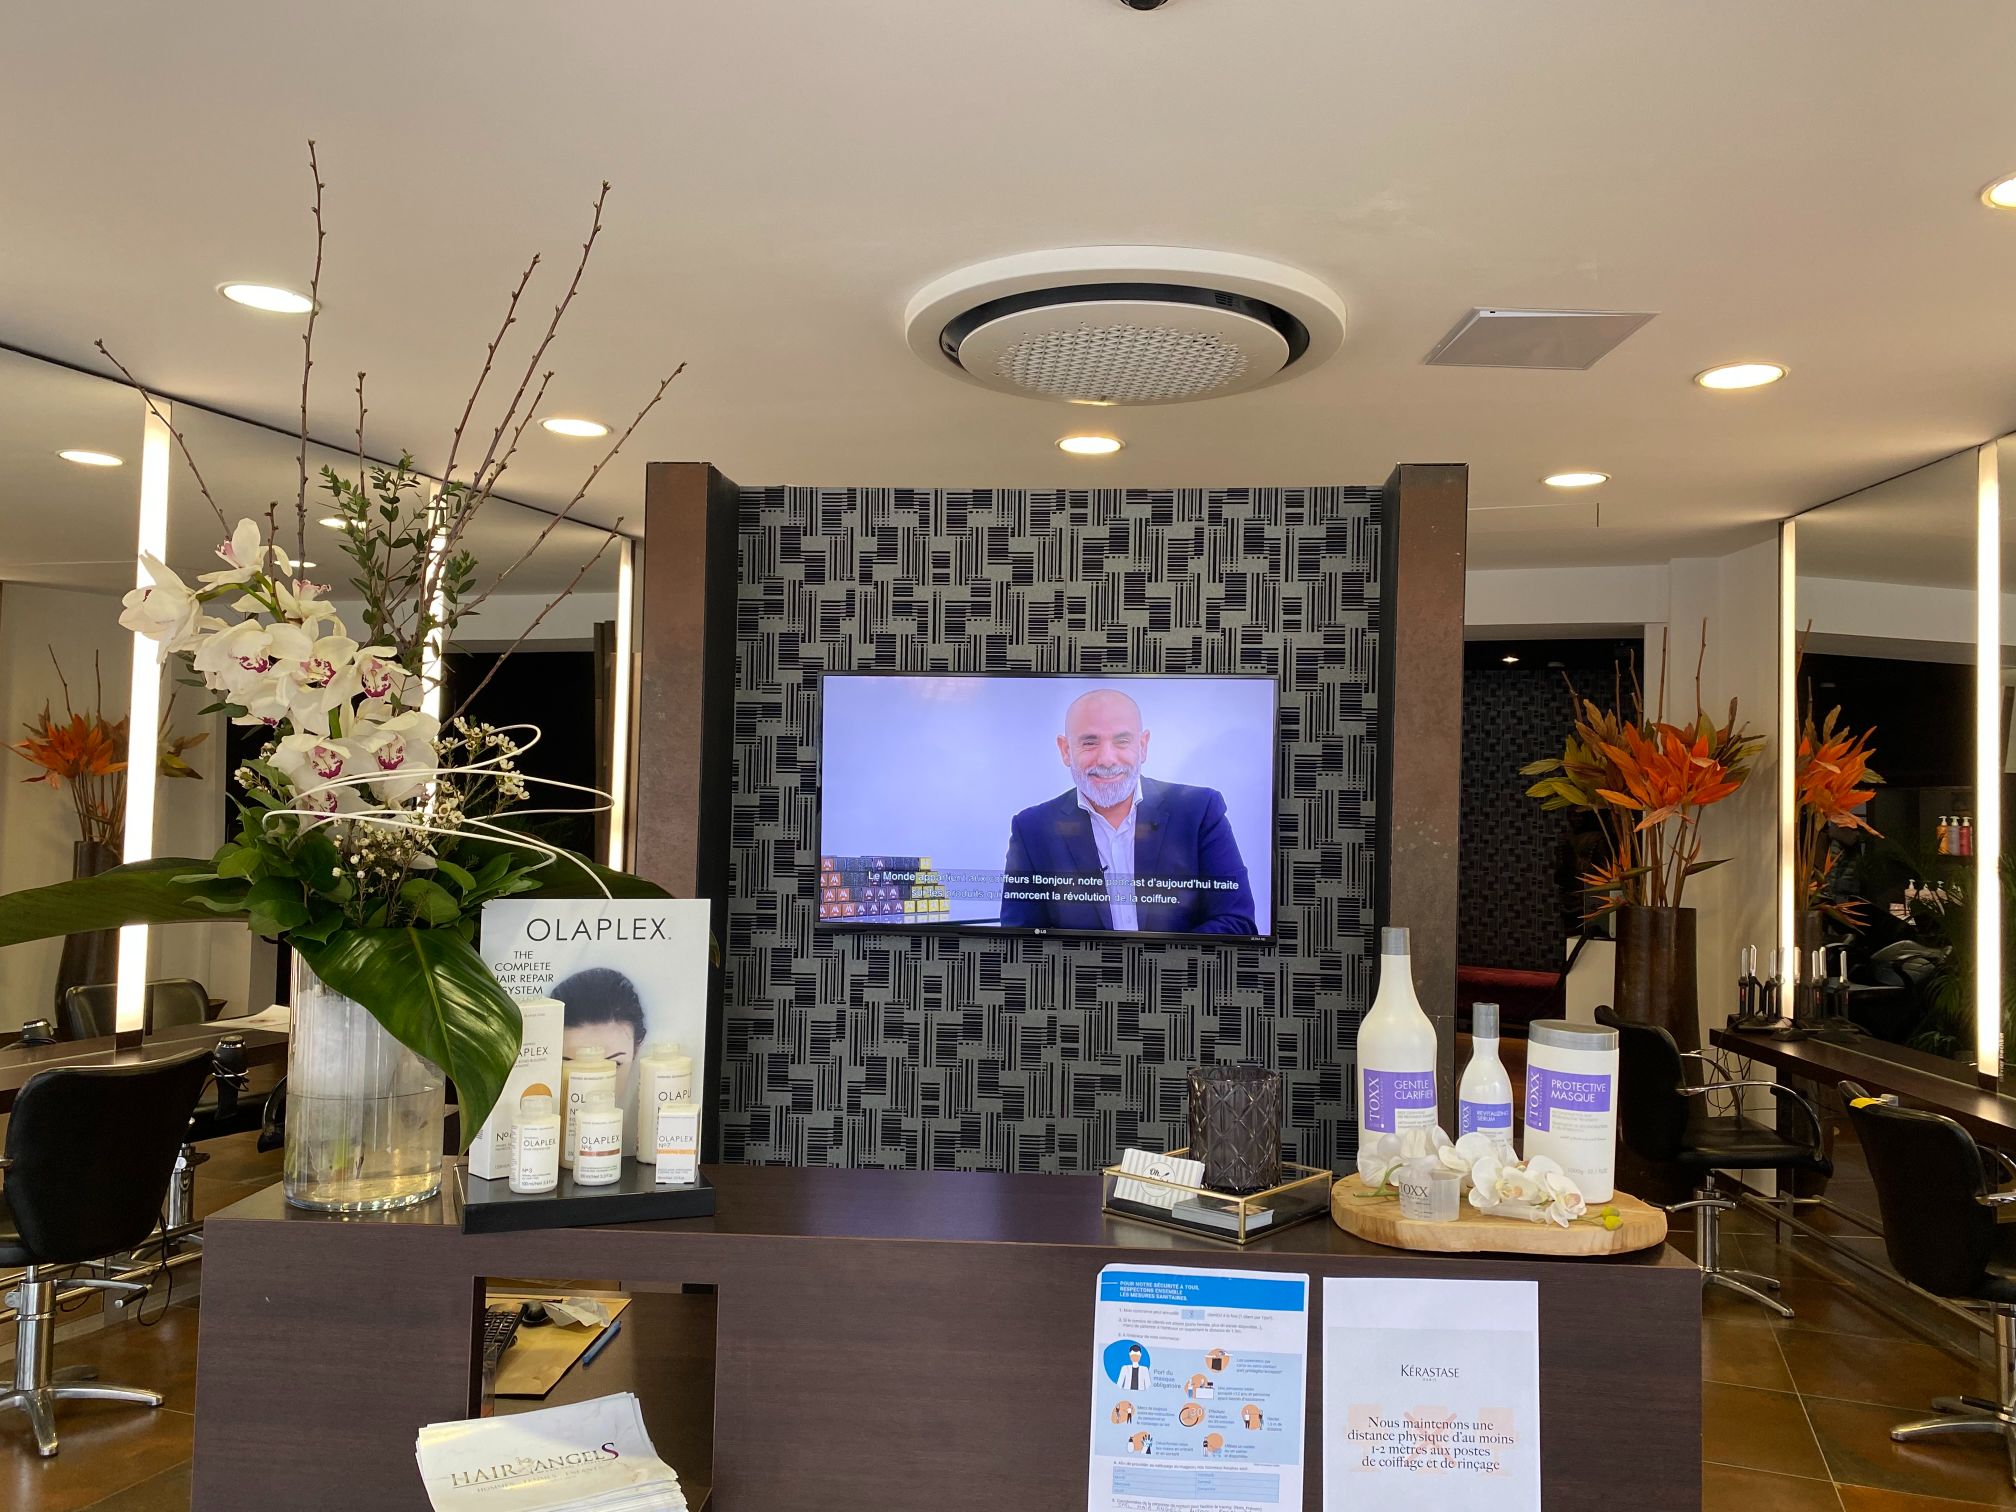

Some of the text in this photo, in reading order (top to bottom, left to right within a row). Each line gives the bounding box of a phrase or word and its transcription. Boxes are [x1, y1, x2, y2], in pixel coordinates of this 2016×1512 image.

[868, 871, 880, 880] Le
[883, 872, 916, 881] Monde
[1078, 877, 1103, 886] notre
[1148, 878, 1211, 889] d'aujourd'hui
[1214, 880, 1239, 890] traite
[1004, 891, 1049, 900] amorcent
[1052, 891, 1060, 900] la
[1063, 892, 1111, 902] révolution
[1141, 894, 1180, 904] coiffure.
[526, 918, 667, 941] OLAPLEX
[514, 950, 534, 959] THE
[494, 962, 551, 971] COMPLETE
[520, 974, 554, 983] REPAIR
[1394, 1080, 1429, 1090] GENTLE
[1551, 1079, 1607, 1093] PROTECTIVE
[1369, 1076, 1380, 1121] TOXX
[1529, 1071, 1540, 1118] TOXX
[1551, 1090, 1596, 1102] MASQUE
[524, 1138, 556, 1147] OLAPLEX
[581, 1135, 620, 1145] OLAPLEX
[1400, 1364, 1460, 1378] KÉRASTASE
[1368, 1416, 1494, 1431] Nous maintenons une
[1347, 1430, 1395, 1441] distance
[1398, 1430, 1449, 1445] physique
[1480, 1434, 1514, 1444] moins
[1372, 1444, 1491, 1458] 1-2 mètres aux postes
[450, 1442, 619, 1487] HAIR ANGELS
[1361, 1456, 1500, 1472] de coiffage et de rinçage
